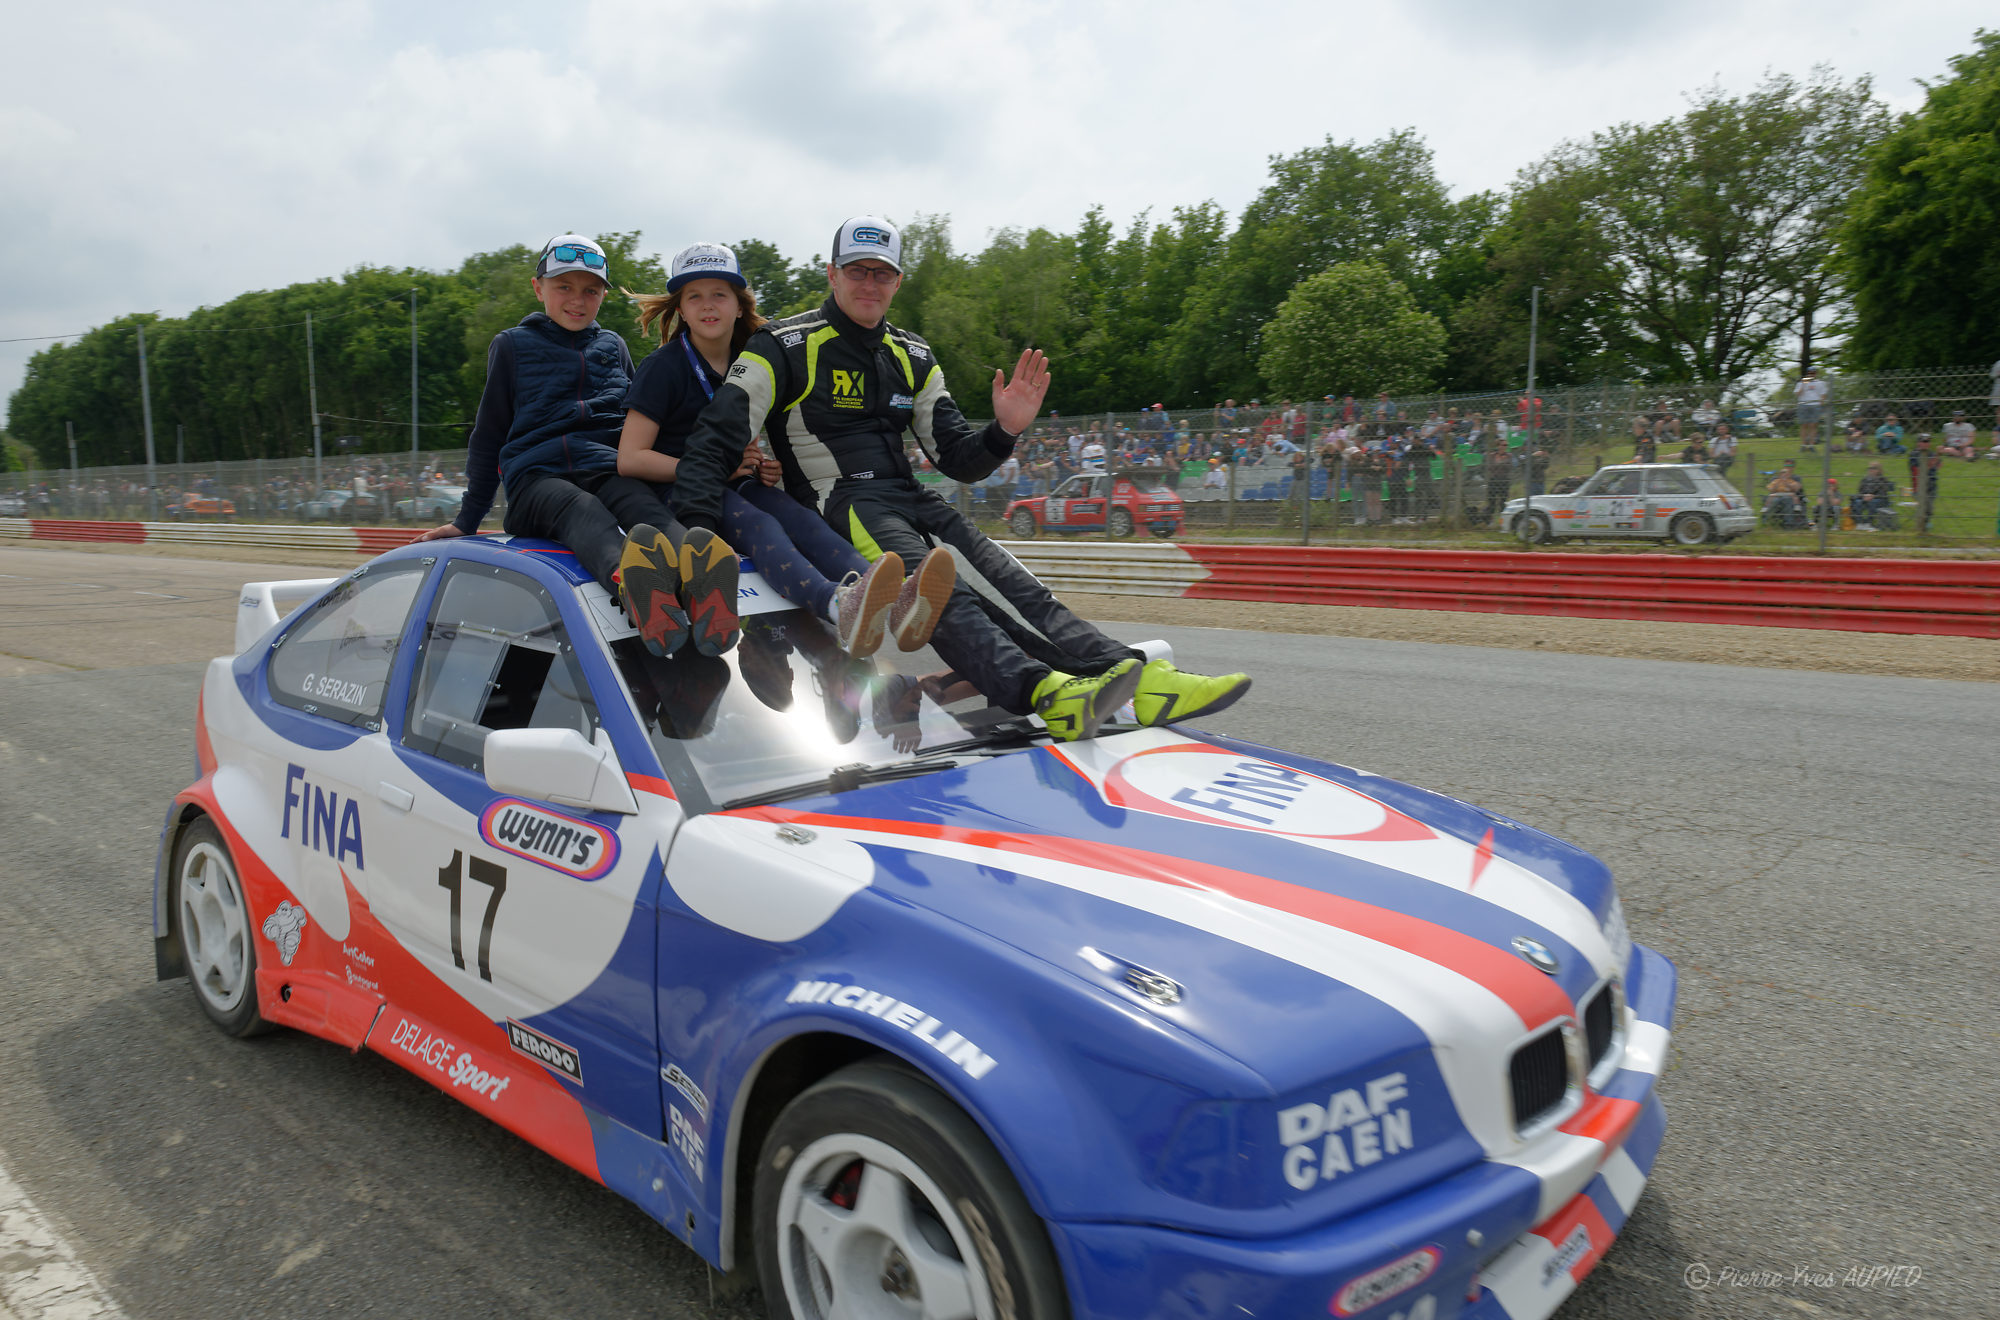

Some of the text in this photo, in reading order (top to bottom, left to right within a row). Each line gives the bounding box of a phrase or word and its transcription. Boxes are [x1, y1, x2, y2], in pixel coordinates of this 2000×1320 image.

[783, 333, 803, 346] OMP
[302, 673, 367, 706] G. SERAZIN
[281, 762, 365, 871] FINA
[1170, 762, 1309, 825] FINA
[438, 848, 507, 984] 17
[390, 1018, 511, 1102] DELAGE Sport
[511, 1026, 575, 1072] FERODO
[785, 980, 999, 1081] MICHELIN
[669, 1103, 704, 1155] DAF
[1277, 1071, 1409, 1147] DAF
[1282, 1107, 1414, 1191] CAEN
